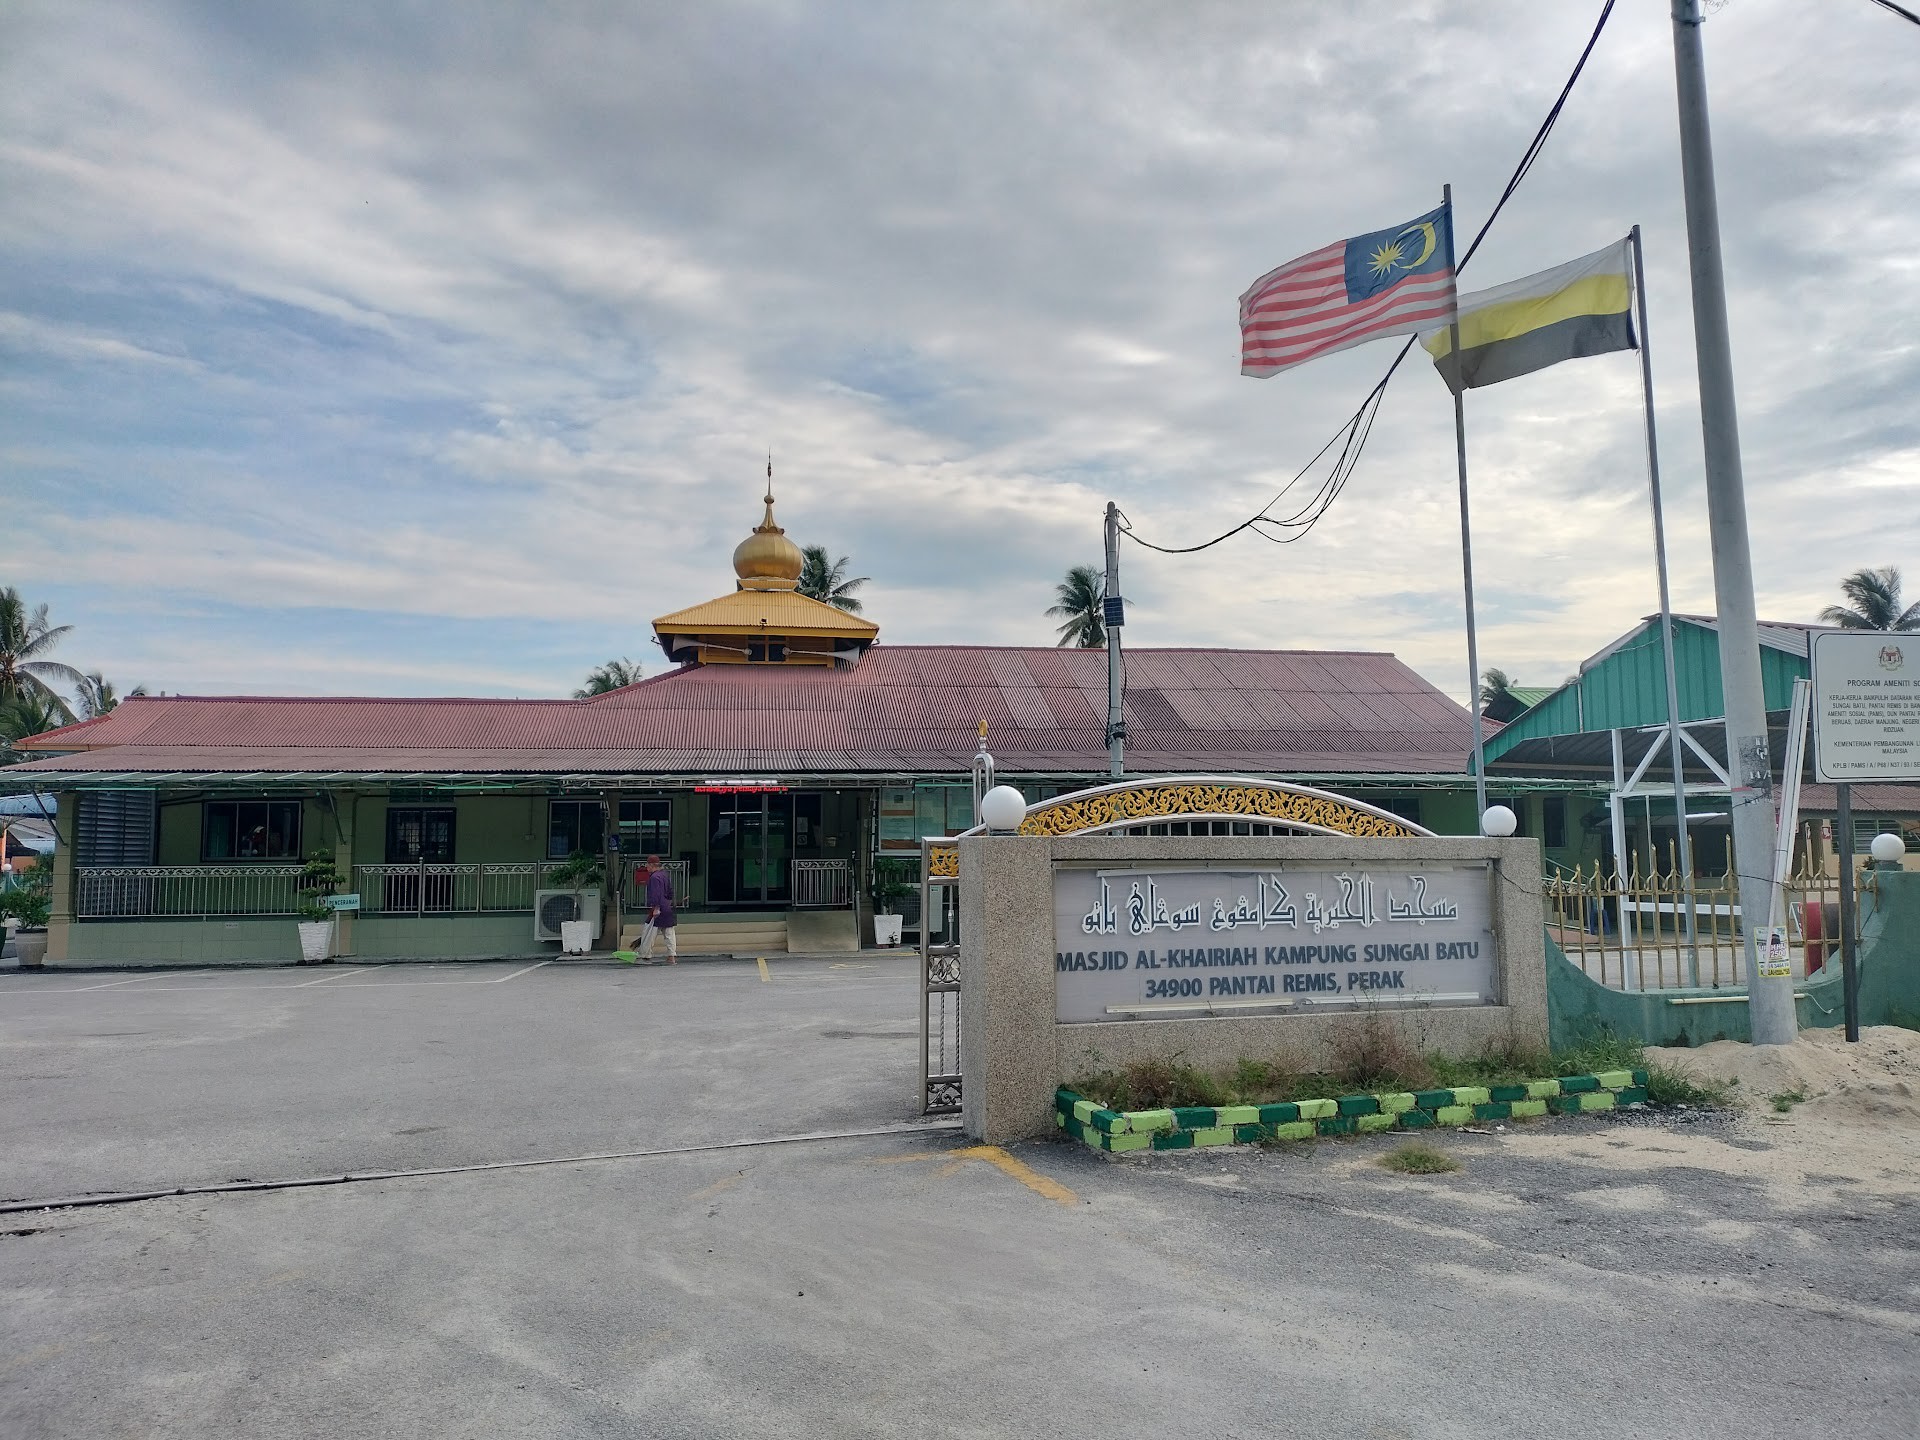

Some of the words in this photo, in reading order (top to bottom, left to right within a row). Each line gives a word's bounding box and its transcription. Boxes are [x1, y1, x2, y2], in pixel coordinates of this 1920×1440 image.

[1081, 877, 1118, 935] باتو
[1387, 874, 1459, 925] مسجد
[1057, 951, 1129, 971] MASJID
[1136, 947, 1257, 969] AL-KHAIRIAH
[1265, 944, 1356, 965] KAMPUNG
[1363, 942, 1429, 962] SUNGAI
[1436, 941, 1480, 960] BATU
[1146, 977, 1202, 998] 34900
[1209, 975, 1275, 995] PANTAI
[1283, 972, 1342, 994] REMIS,
[1347, 970, 1405, 991] PERAK
